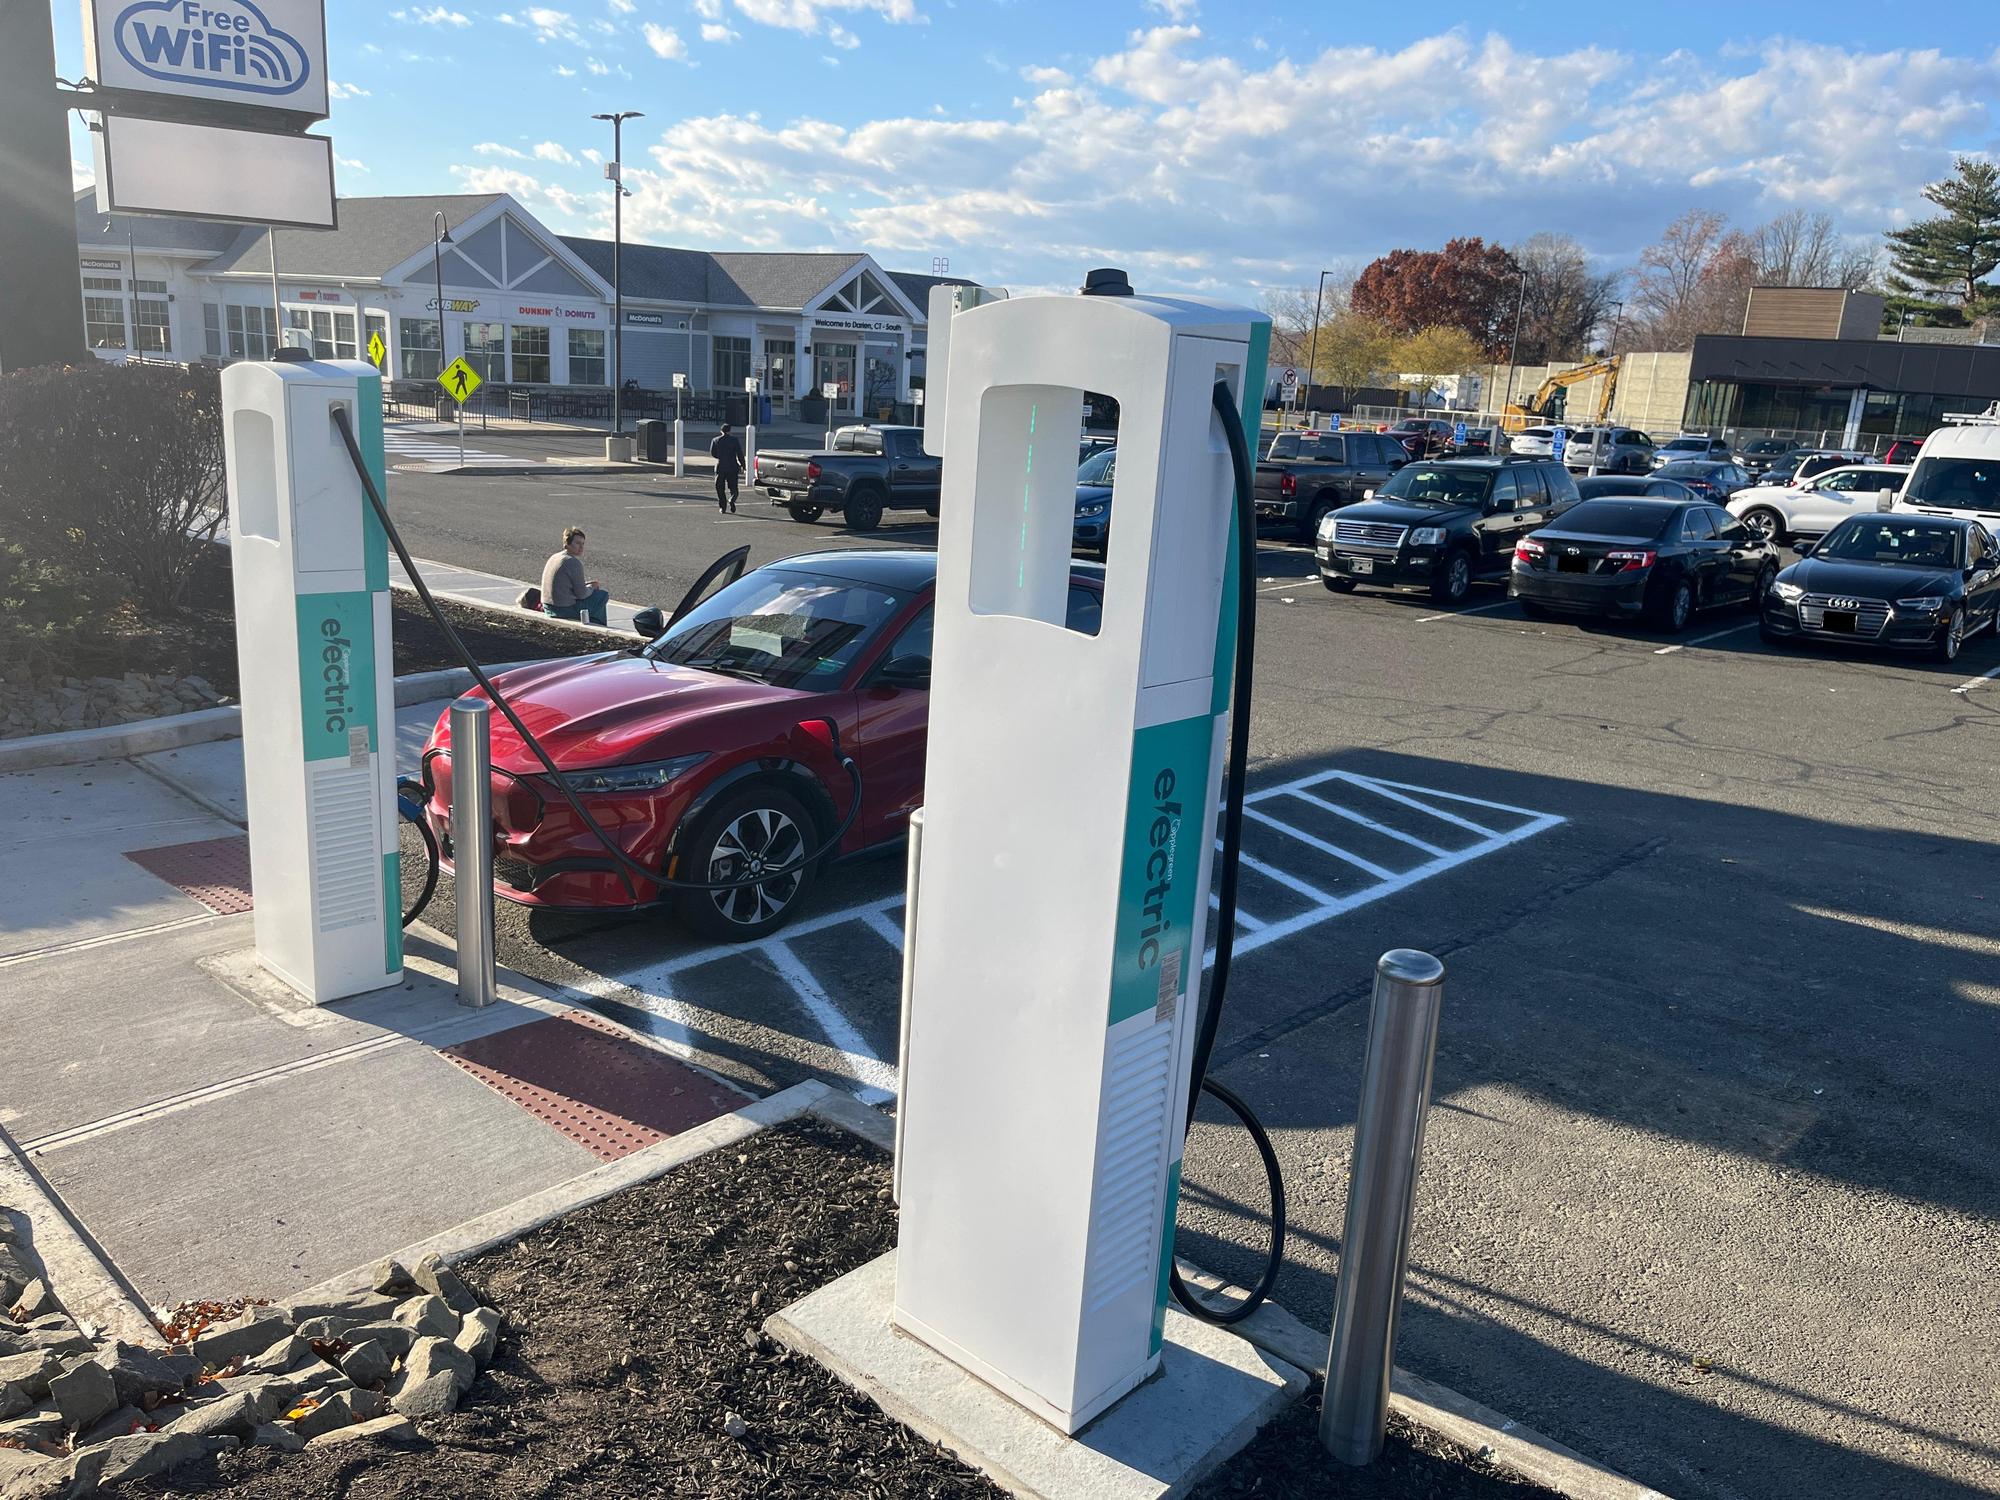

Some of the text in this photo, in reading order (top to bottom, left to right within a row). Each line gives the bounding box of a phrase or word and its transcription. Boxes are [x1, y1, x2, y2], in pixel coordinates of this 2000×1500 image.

[183, 1, 250, 32] Free
[132, 21, 246, 75] WiFi
[425, 298, 480, 313] SUBWAY
[519, 307, 595, 319] DUNKIN' DONUTS
[629, 314, 662, 323] McDonald's
[815, 319, 844, 328] Welcome
[845, 320, 851, 328] to
[852, 320, 873, 330] Darien,
[874, 322, 882, 330] CT
[886, 323, 902, 331] South
